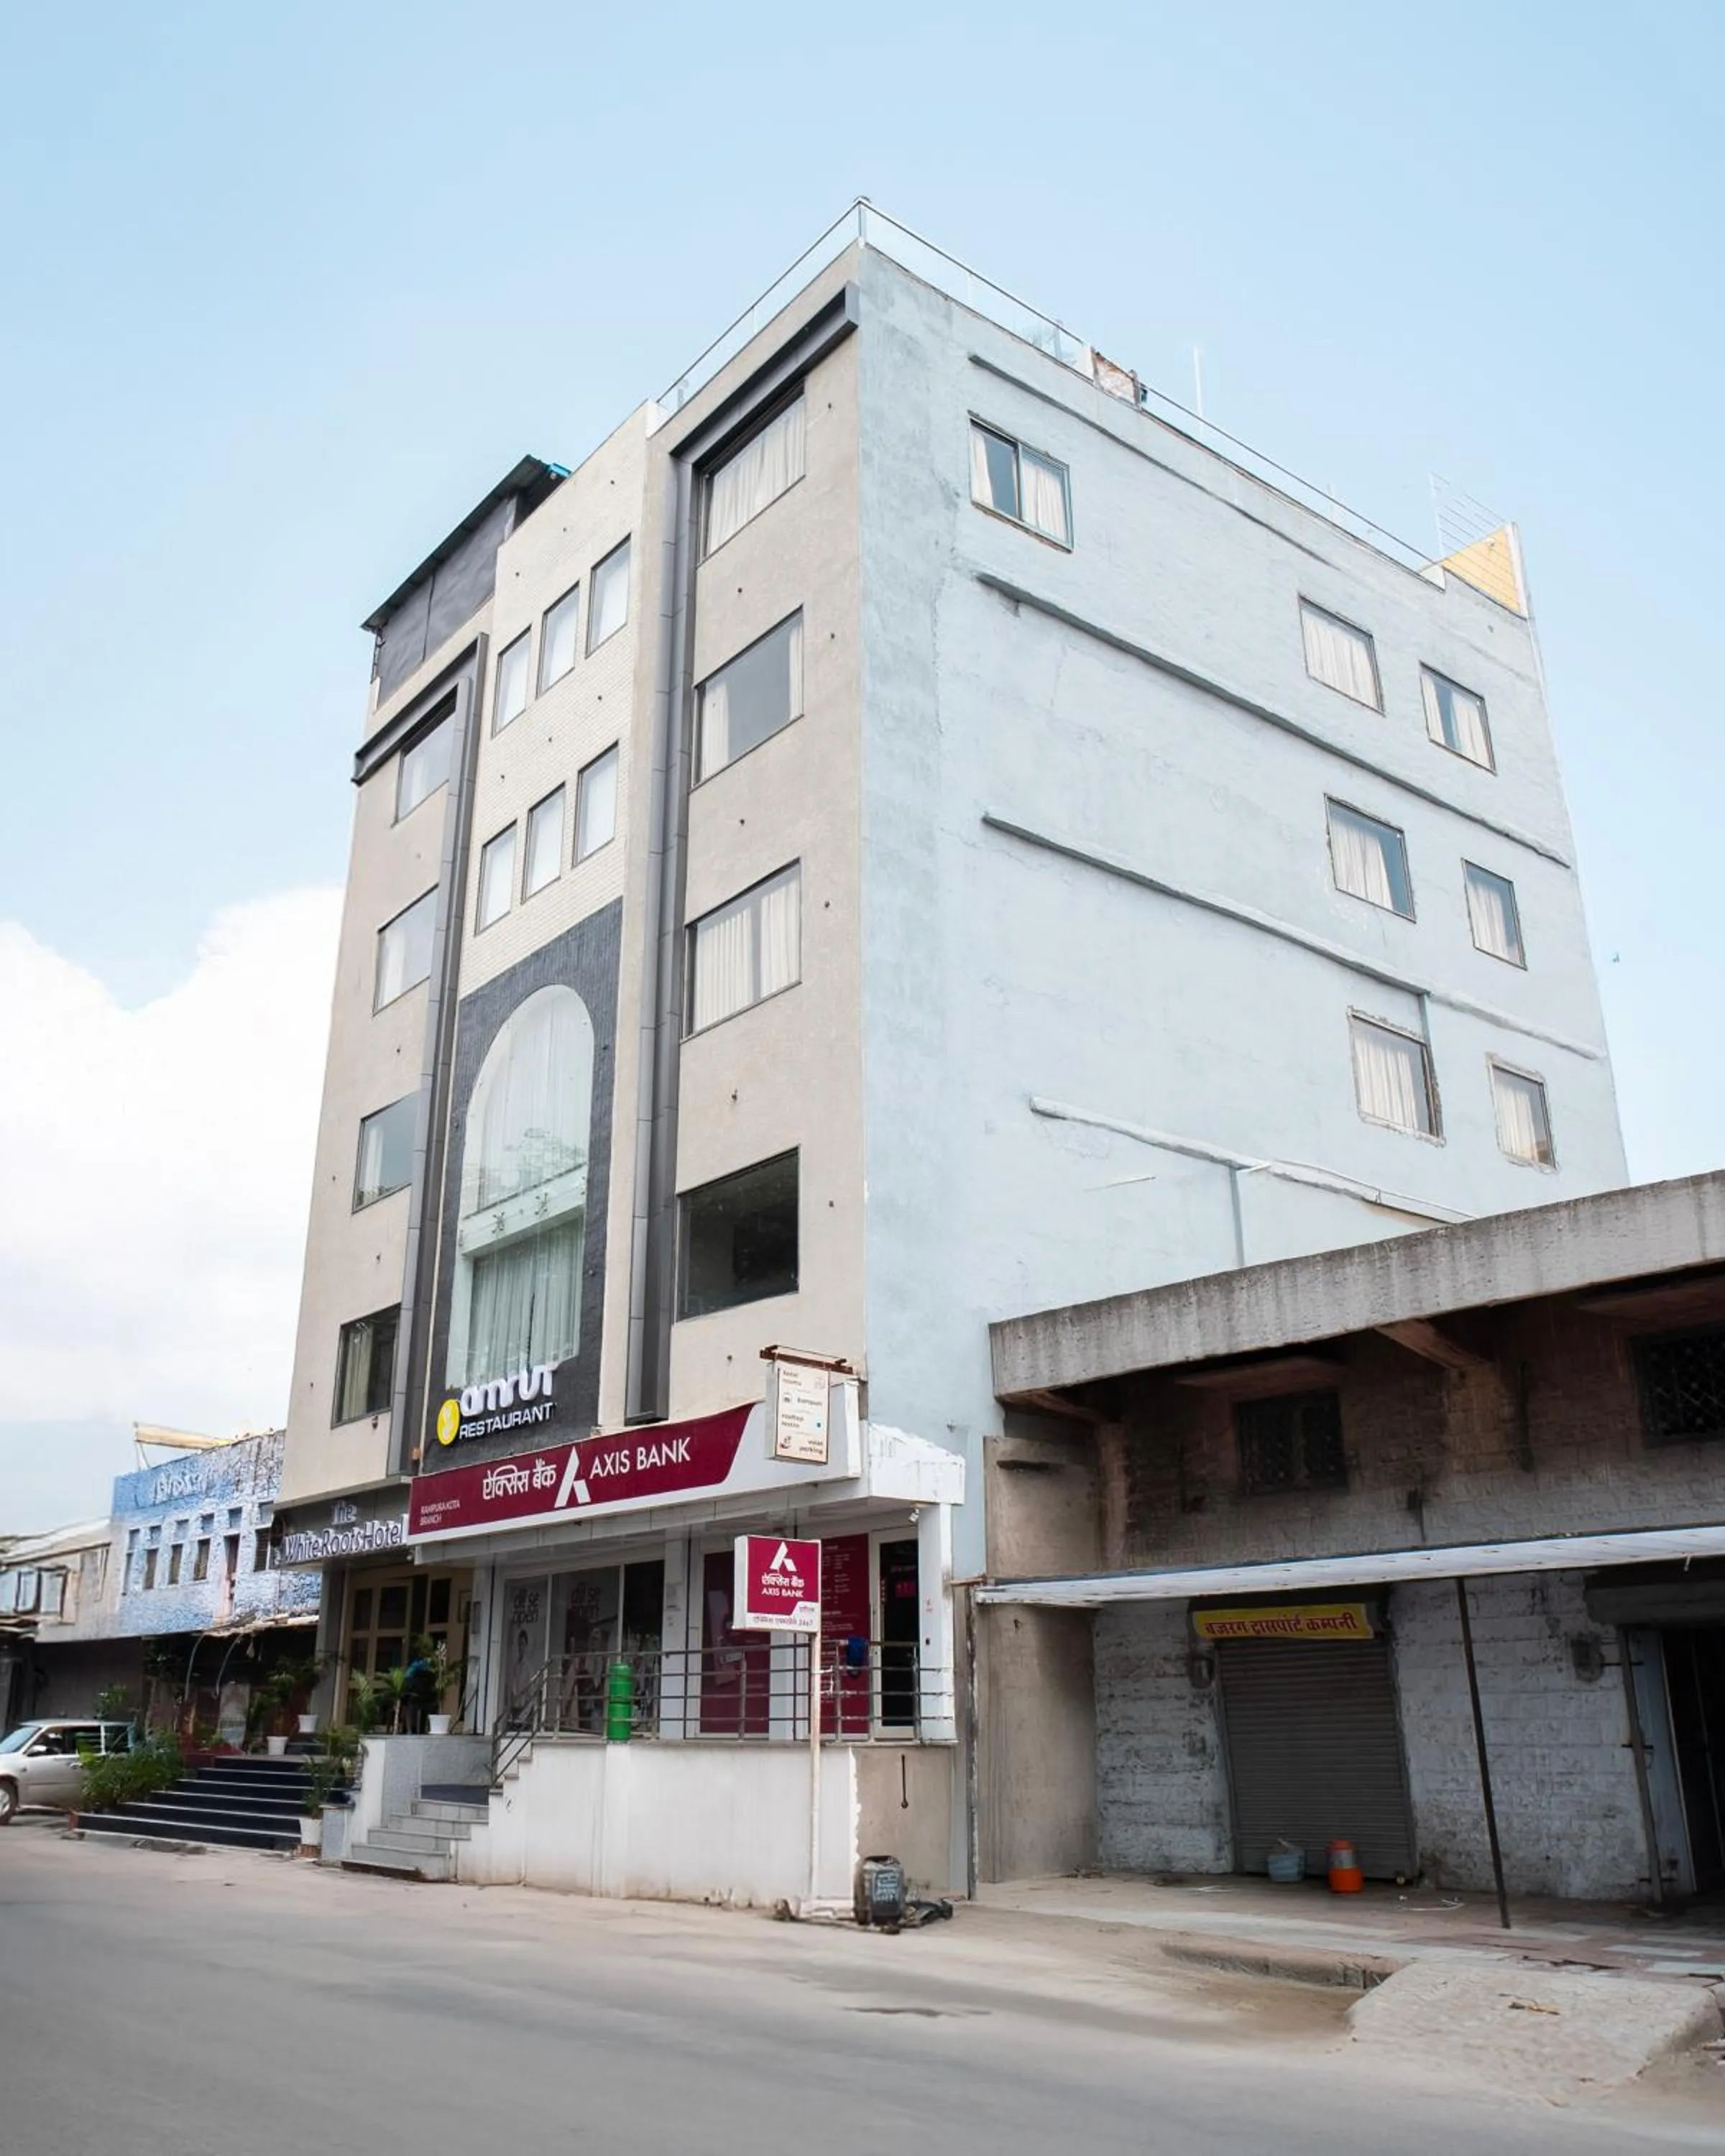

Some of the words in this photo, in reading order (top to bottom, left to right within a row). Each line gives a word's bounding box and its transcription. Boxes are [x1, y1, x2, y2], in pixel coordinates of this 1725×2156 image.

[460, 1361, 556, 1416] amrut
[459, 1402, 553, 1439] RESTAURANT
[533, 1457, 557, 1489] बैंक
[589, 1449, 630, 1480] AXIS
[636, 1437, 691, 1470] BANK
[282, 1531, 323, 1563] White
[322, 1526, 364, 1556] Roots
[362, 1514, 408, 1551] Hotel
[760, 1587, 780, 1596] AXIS
[781, 1588, 804, 1598] BANK
